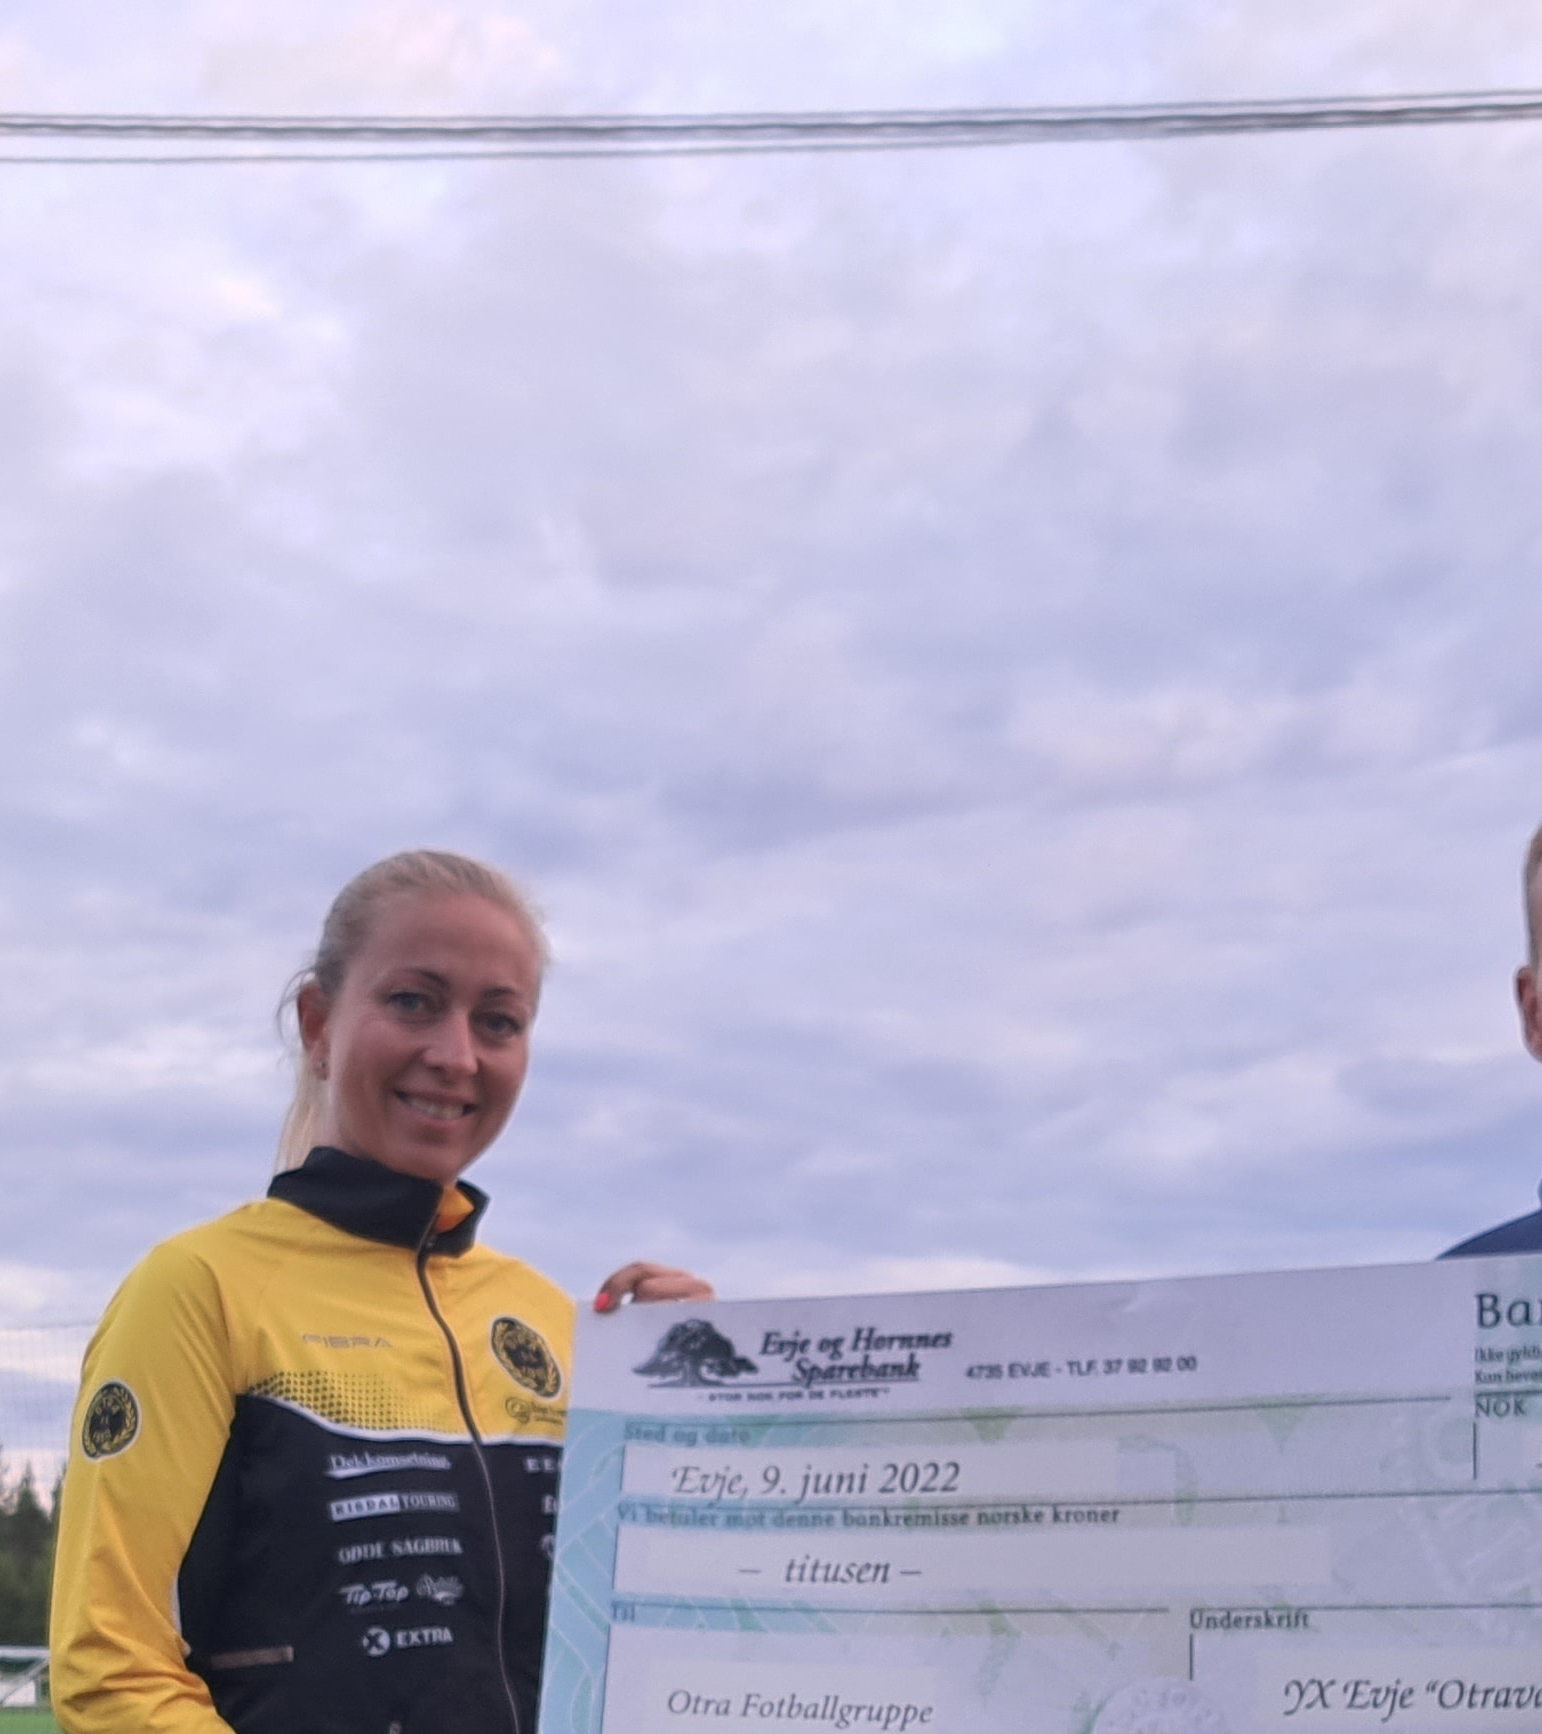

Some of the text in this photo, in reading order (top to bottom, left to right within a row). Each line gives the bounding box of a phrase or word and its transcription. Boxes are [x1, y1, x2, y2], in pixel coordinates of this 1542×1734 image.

[760, 1327, 953, 1362] Evje og Hornnes
[792, 1352, 921, 1388] Sparebank
[1008, 1361, 1050, 1378] EVJE
[1475, 1397, 1526, 1418] NOK
[623, 1423, 665, 1441] Sted
[674, 1427, 698, 1446] og
[672, 1461, 960, 1506] Evje, 9. juni 2022
[617, 1502, 637, 1521] Vi
[726, 1510, 765, 1528] mot
[773, 1508, 836, 1527] denne
[842, 1507, 969, 1527] bankremisse
[977, 1505, 1044, 1526] norske
[1053, 1503, 1120, 1524] kroner
[785, 1555, 891, 1585] titusen
[1189, 1608, 1310, 1630] Underskrift
[396, 1626, 454, 1648] EXTRA
[667, 1688, 934, 1729] Otra Fotballgruppe
[1343, 1677, 1414, 1722] Evje
